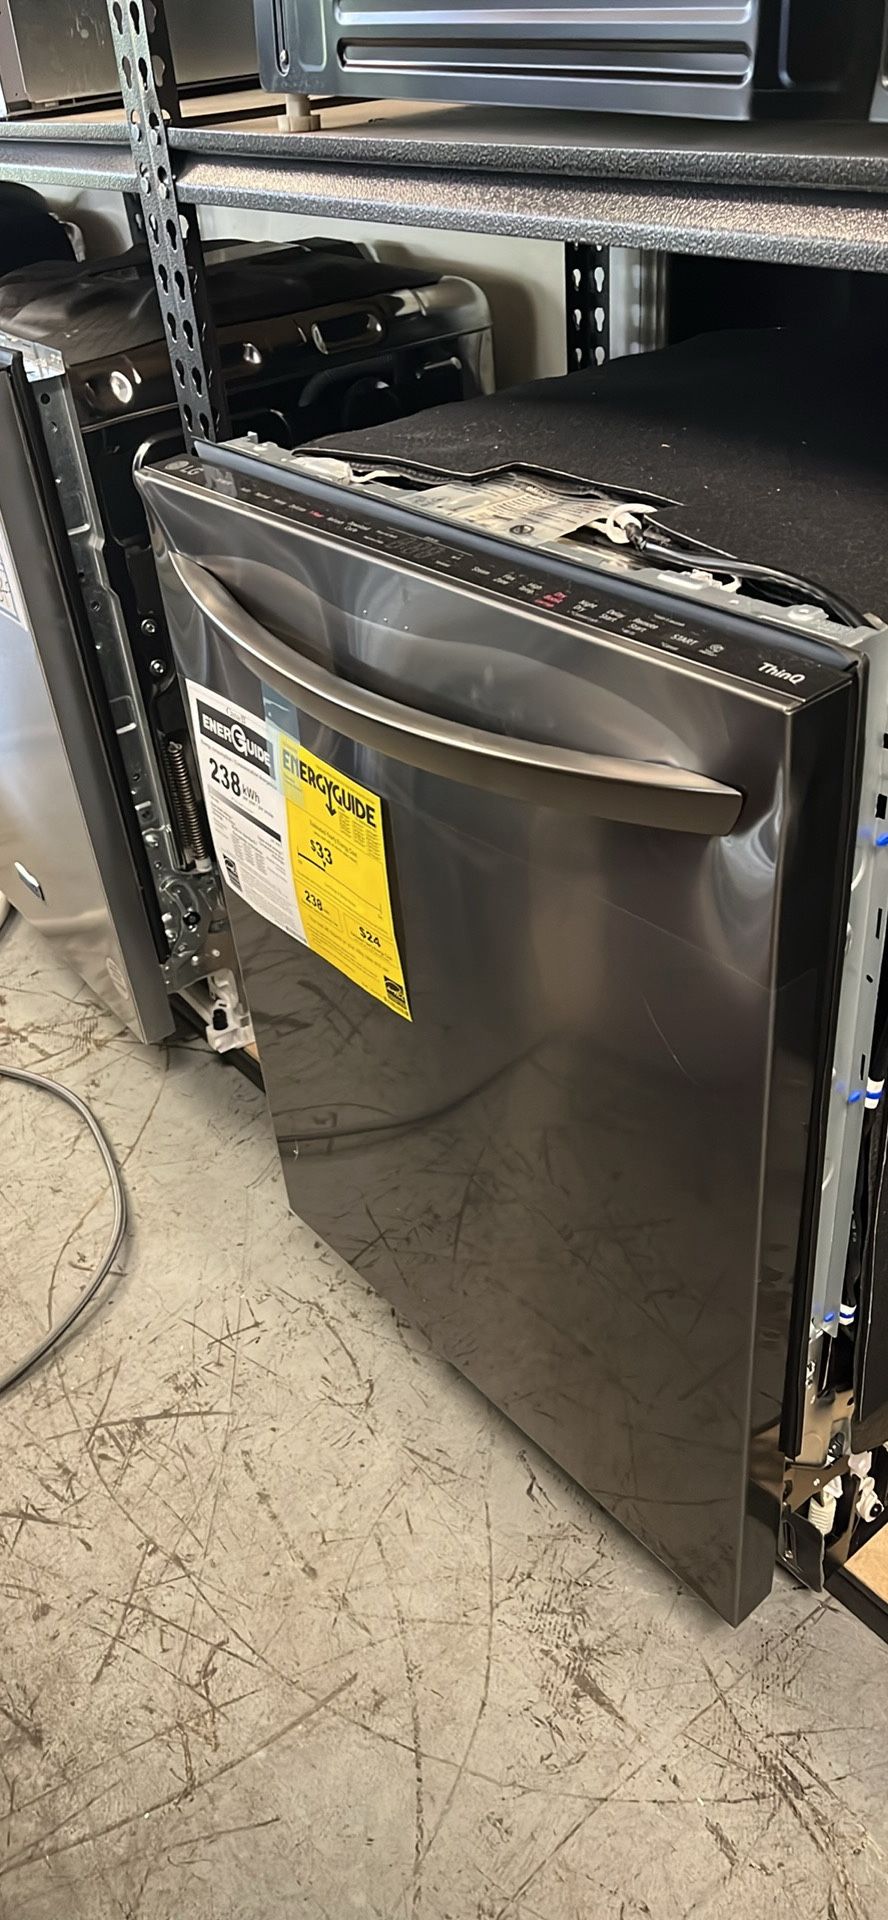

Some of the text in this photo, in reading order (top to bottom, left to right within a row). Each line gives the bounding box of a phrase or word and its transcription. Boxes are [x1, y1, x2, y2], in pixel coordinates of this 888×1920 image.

[180, 464, 204, 476] LG
[670, 633, 700, 646] START
[757, 661, 806, 685] ThinQ
[209, 757, 242, 797] 238
[242, 783, 261, 805] kWh
[282, 748, 377, 828] ENERGYGUIDE
[310, 839, 333, 865] $33
[304, 890, 324, 912] 238
[358, 926, 382, 948] $24
